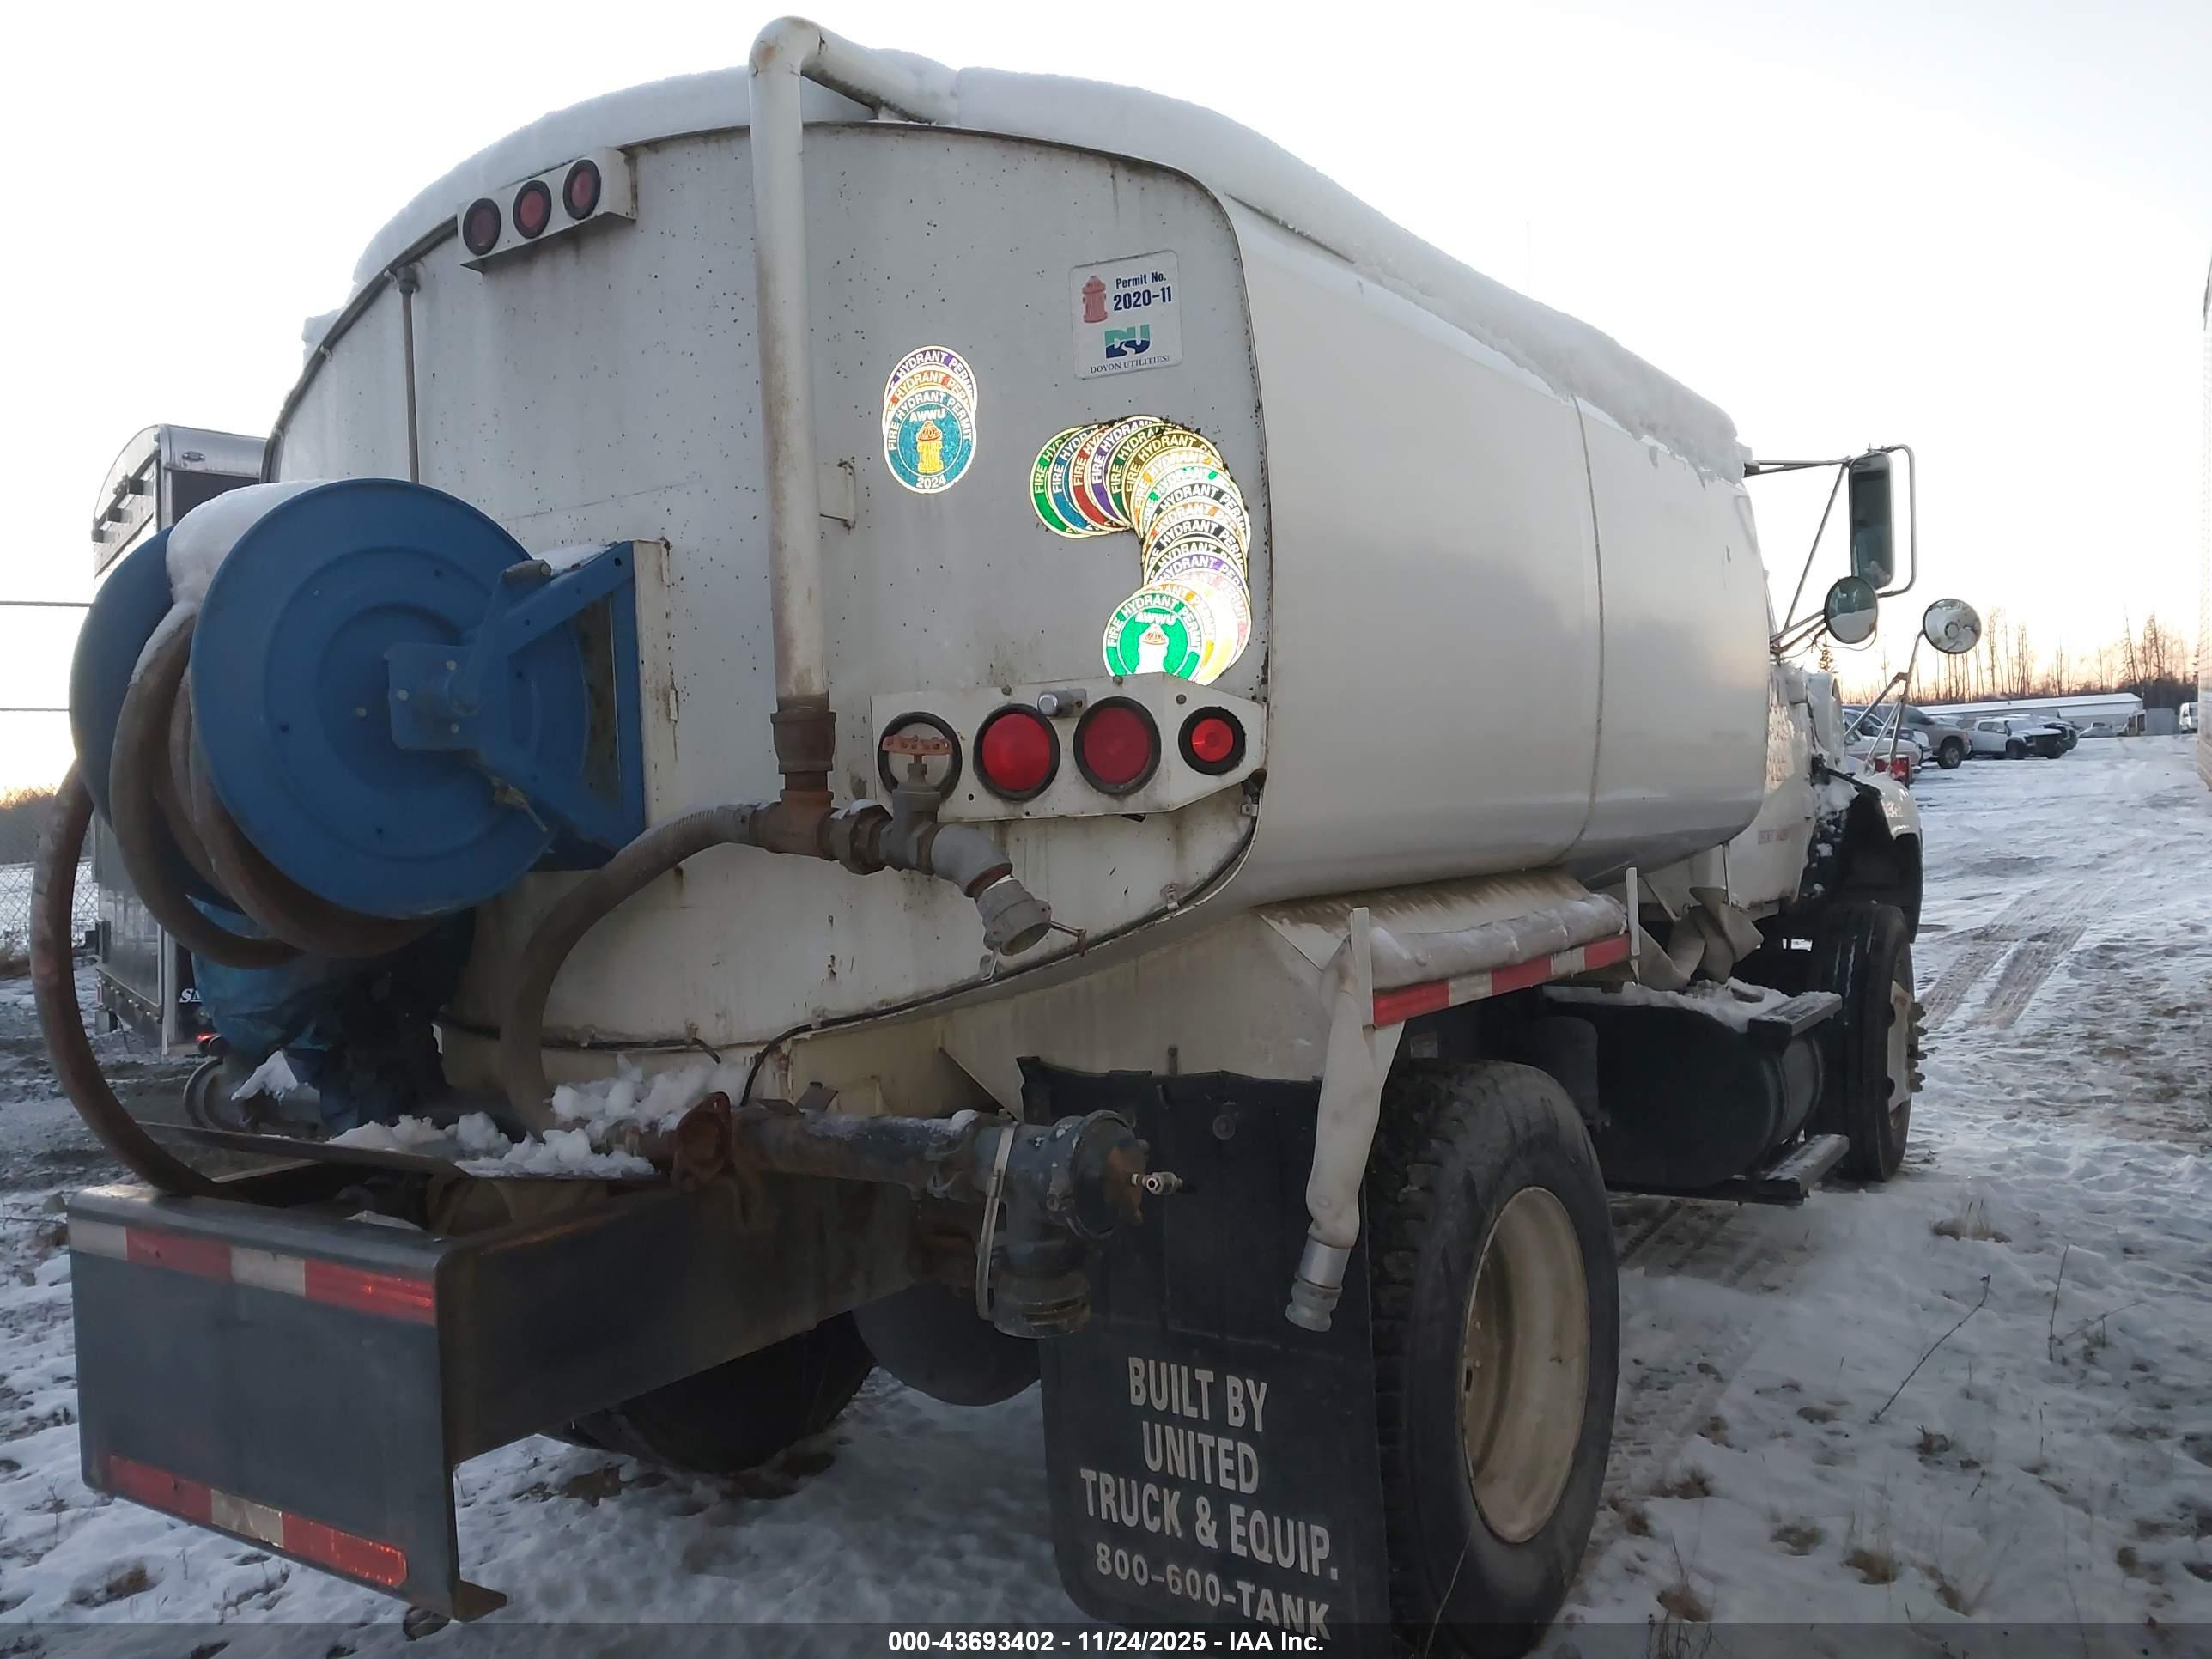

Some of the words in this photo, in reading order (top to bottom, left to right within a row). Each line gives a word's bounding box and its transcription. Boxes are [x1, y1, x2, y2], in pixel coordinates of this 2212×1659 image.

[1115, 273, 1147, 289] Permit
[1152, 270, 1167, 283] No.
[1113, 286, 1172, 311] 2020-11
[896, 350, 948, 379] HYDRANT
[1091, 362, 1121, 374] DOYON
[896, 370, 946, 398] HYDRANT
[888, 422, 901, 451] FIRE
[896, 391, 946, 421] HYDRANT
[947, 397, 972, 441] PERMIT
[910, 408, 946, 422] AWWU
[1074, 456, 1087, 486] FIRE
[1091, 453, 1105, 484] FIRE
[1127, 462, 1140, 492] FIRE
[1138, 434, 1197, 461] HYDRANT
[916, 473, 946, 489] 2024
[1035, 465, 1047, 494] FIRE
[1052, 464, 1065, 494] FIRE
[1111, 465, 1123, 494] FIRE
[1160, 484, 1219, 511] HYDRANT
[1159, 520, 1218, 547] HYDRANT
[1158, 542, 1217, 568] HYDRANT
[1159, 555, 1218, 580] HYDRANT
[1107, 617, 1123, 647] FIRE
[1121, 594, 1179, 618] HYDRANT
[1128, 1356, 1214, 1421] BUILT
[1226, 1375, 1267, 1432] BY
[1142, 1420, 1259, 1494] UNITED
[1080, 1468, 1182, 1539] TRUCK
[1195, 1496, 1218, 1549] &
[1229, 1504, 1338, 1581] EQUIP.
[1096, 1542, 1331, 1640] 800-600-TANK
